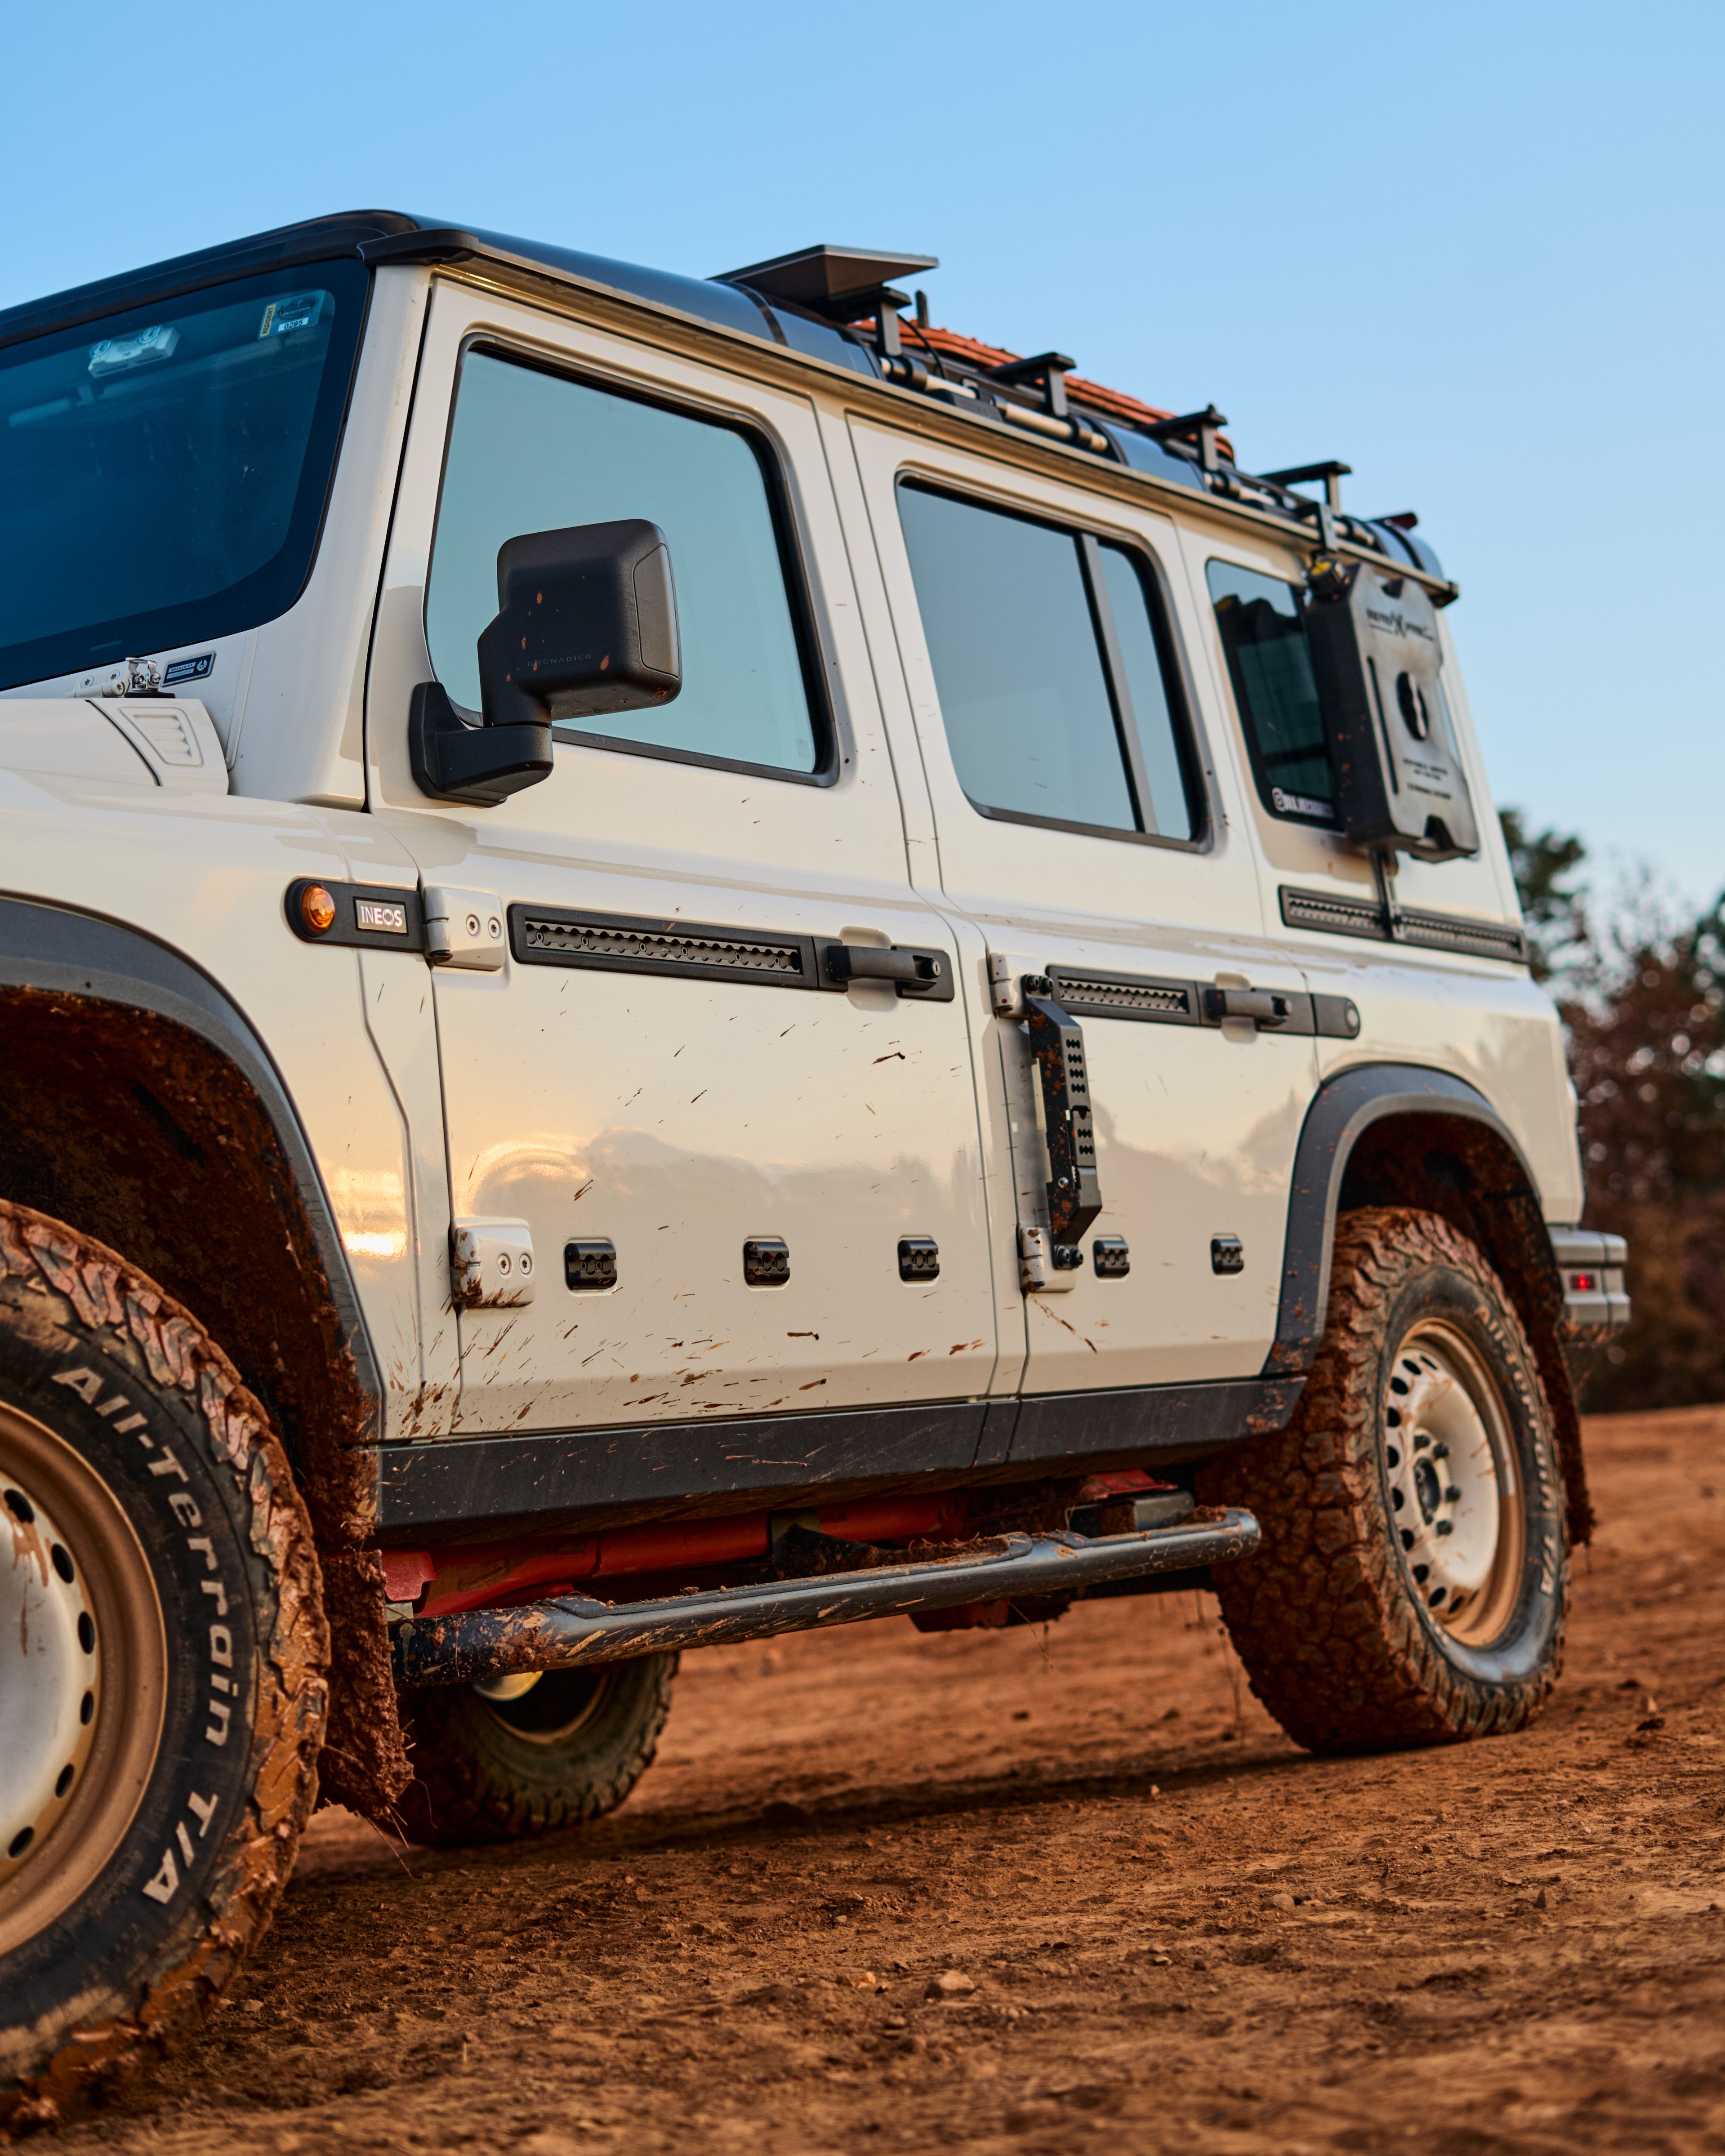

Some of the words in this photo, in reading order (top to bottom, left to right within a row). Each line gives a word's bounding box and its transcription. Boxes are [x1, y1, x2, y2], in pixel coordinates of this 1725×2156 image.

[262, 307, 274, 334] RESIDENT
[284, 319, 303, 330] 0295
[527, 654, 592, 667] GRENADIER
[361, 906, 402, 927] INEOS
[52, 1366, 238, 1746] All-Terrain
[142, 1791, 218, 1905] T/A
